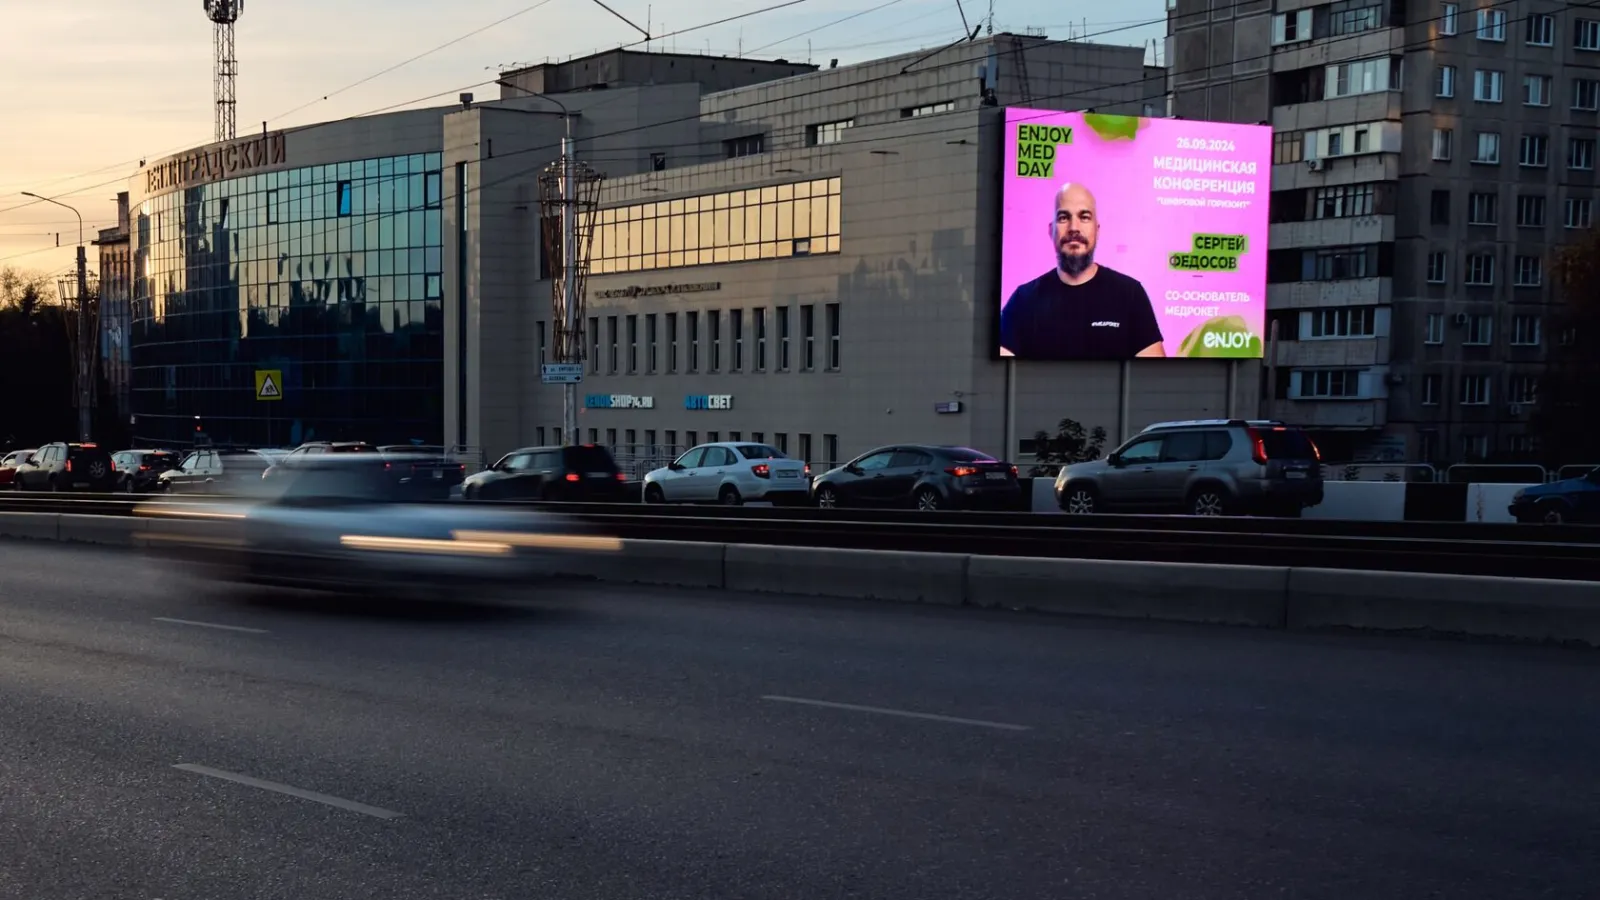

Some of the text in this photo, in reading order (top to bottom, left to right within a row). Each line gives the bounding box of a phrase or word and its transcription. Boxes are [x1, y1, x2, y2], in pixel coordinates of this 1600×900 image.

[1018, 125, 1072, 143] ENJOY
[1018, 143, 1055, 160] MED
[1176, 137, 1236, 152] 26.09.2024
[1017, 161, 1052, 177] DAY
[1153, 155, 1257, 175] МЕДИЦИНСКАЯ
[1153, 176, 1256, 195] КОНФЕРЕНЦИЯ
[1195, 235, 1245, 251] СЕРГЕЙ
[1169, 254, 1237, 270] ФЕДОСОВ
[1165, 290, 1250, 302] СО-ОСНОВАТЕЛЬ
[1165, 306, 1219, 317] МЕДРОКЕТ
